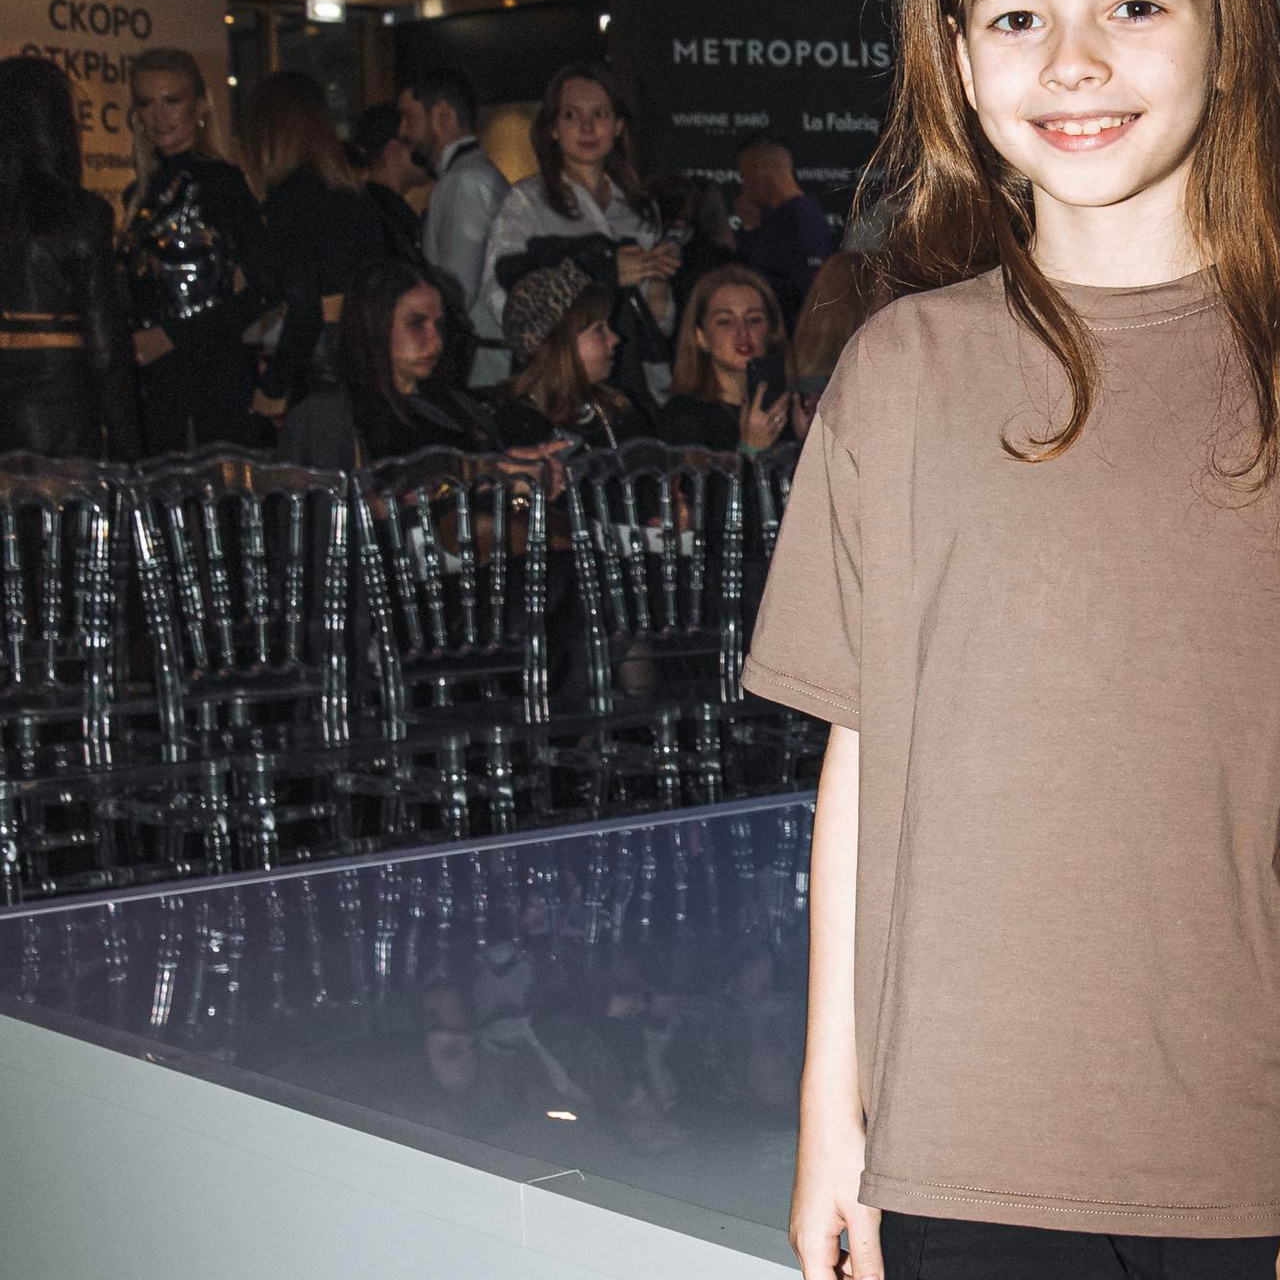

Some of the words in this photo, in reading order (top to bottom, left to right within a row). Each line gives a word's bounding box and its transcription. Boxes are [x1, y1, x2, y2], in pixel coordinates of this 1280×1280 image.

[673, 38, 892, 67] METROPOLIS
[803, 113, 823, 131] La
[826, 112, 880, 135] Fabriq
